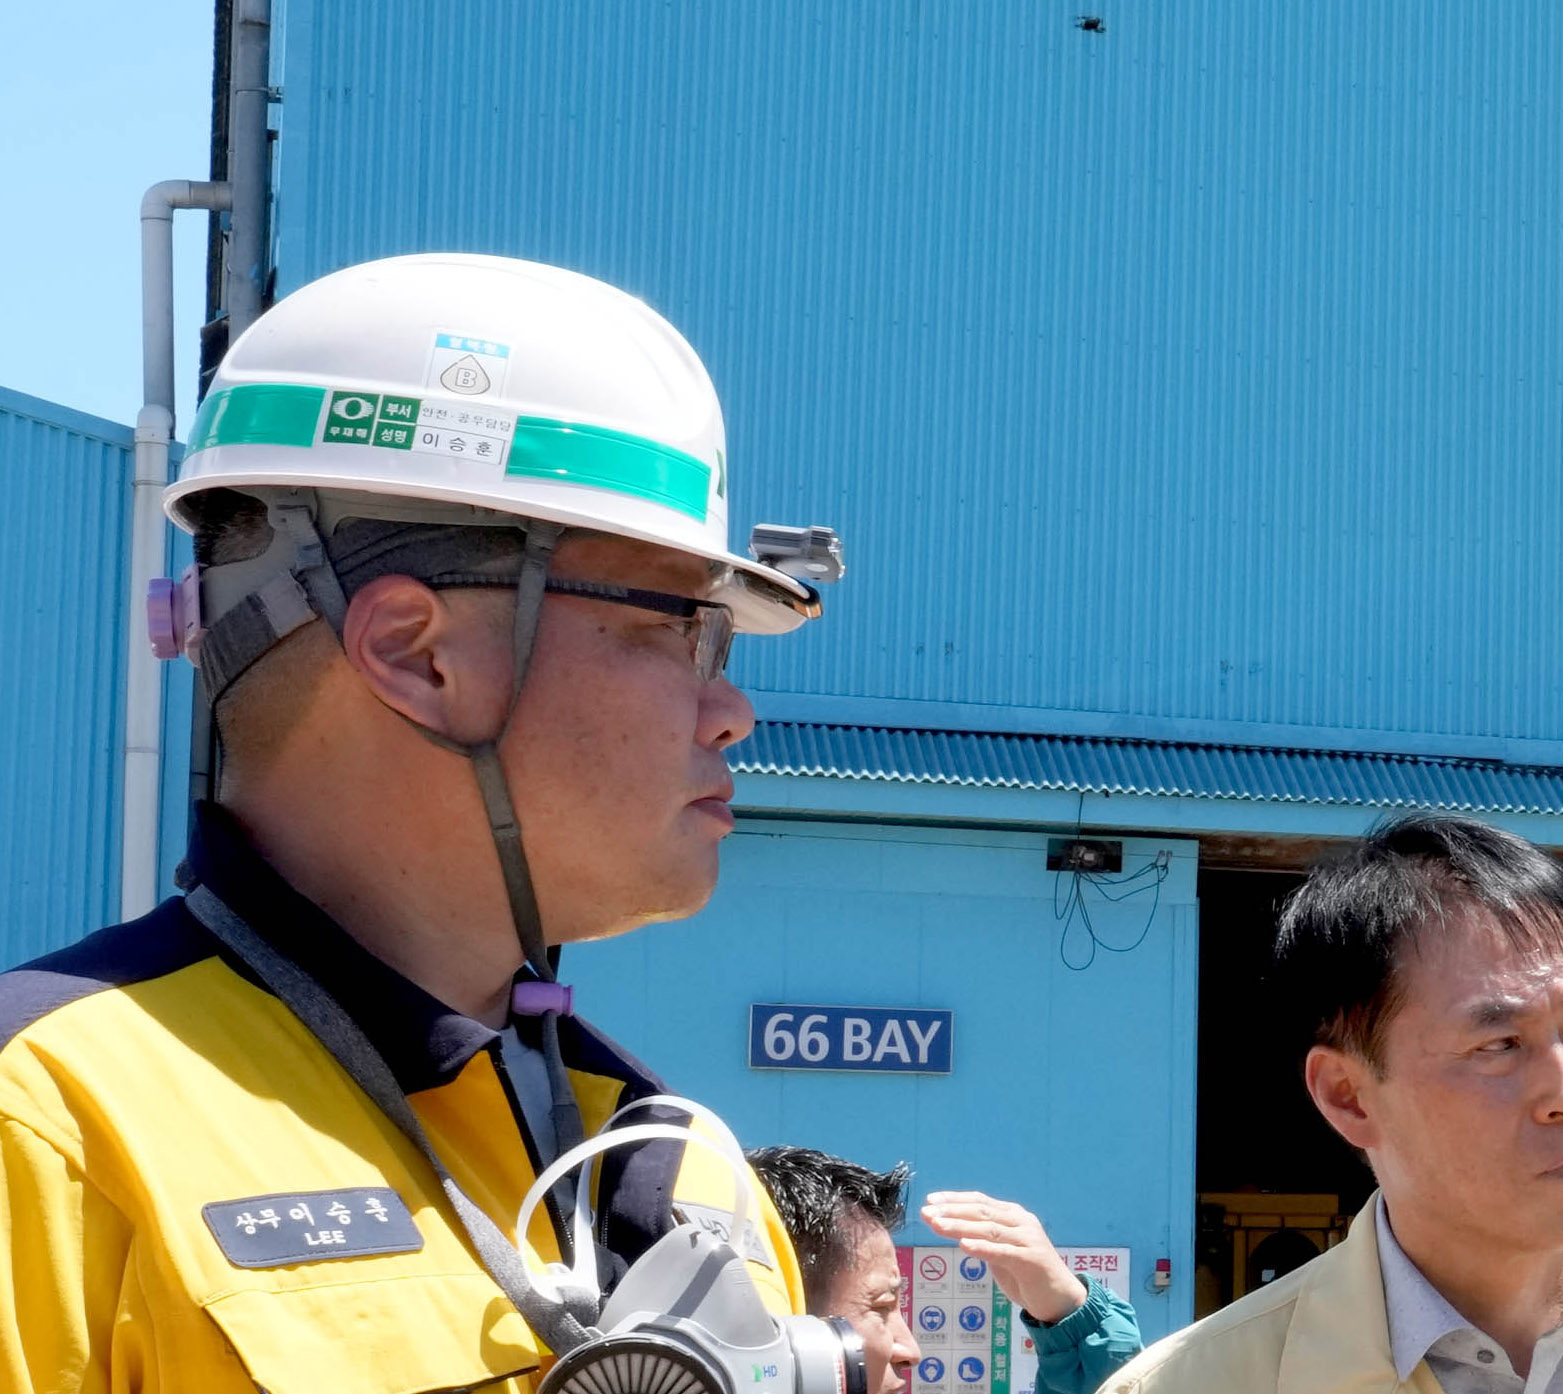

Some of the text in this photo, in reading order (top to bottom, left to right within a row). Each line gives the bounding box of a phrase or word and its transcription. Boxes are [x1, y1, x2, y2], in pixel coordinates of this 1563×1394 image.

[455, 367, 477, 389] B
[385, 402, 412, 418] 부서
[380, 428, 407, 443] 성명
[764, 1012, 942, 1064] 66 BAY
[236, 1208, 282, 1235] 상무
[304, 1230, 346, 1246] LEE
[763, 1364, 778, 1378] HD
